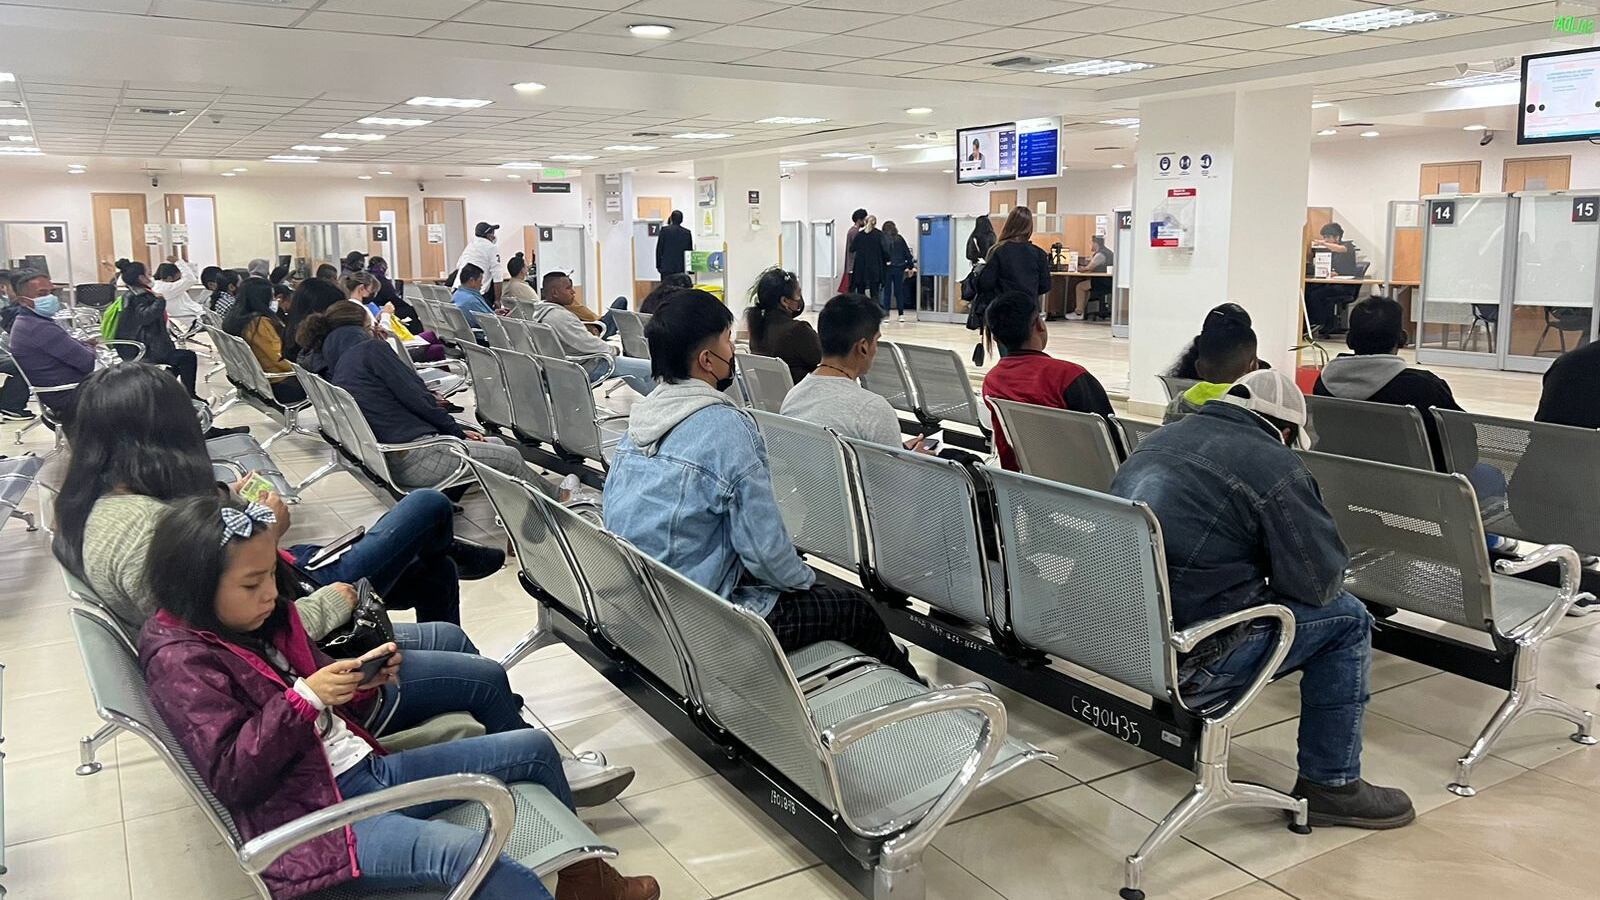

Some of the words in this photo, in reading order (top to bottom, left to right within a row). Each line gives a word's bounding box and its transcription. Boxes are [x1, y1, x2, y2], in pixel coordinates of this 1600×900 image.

[1435, 206, 1451, 219] 14
[1576, 202, 1594, 217] 15
[1122, 215, 1132, 226] 12
[652, 225, 657, 233] 7
[921, 222, 930, 232] 10
[50, 230, 58, 240] 3
[284, 230, 291, 239] 4
[377, 230, 383, 238] 5
[543, 230, 549, 239] 6
